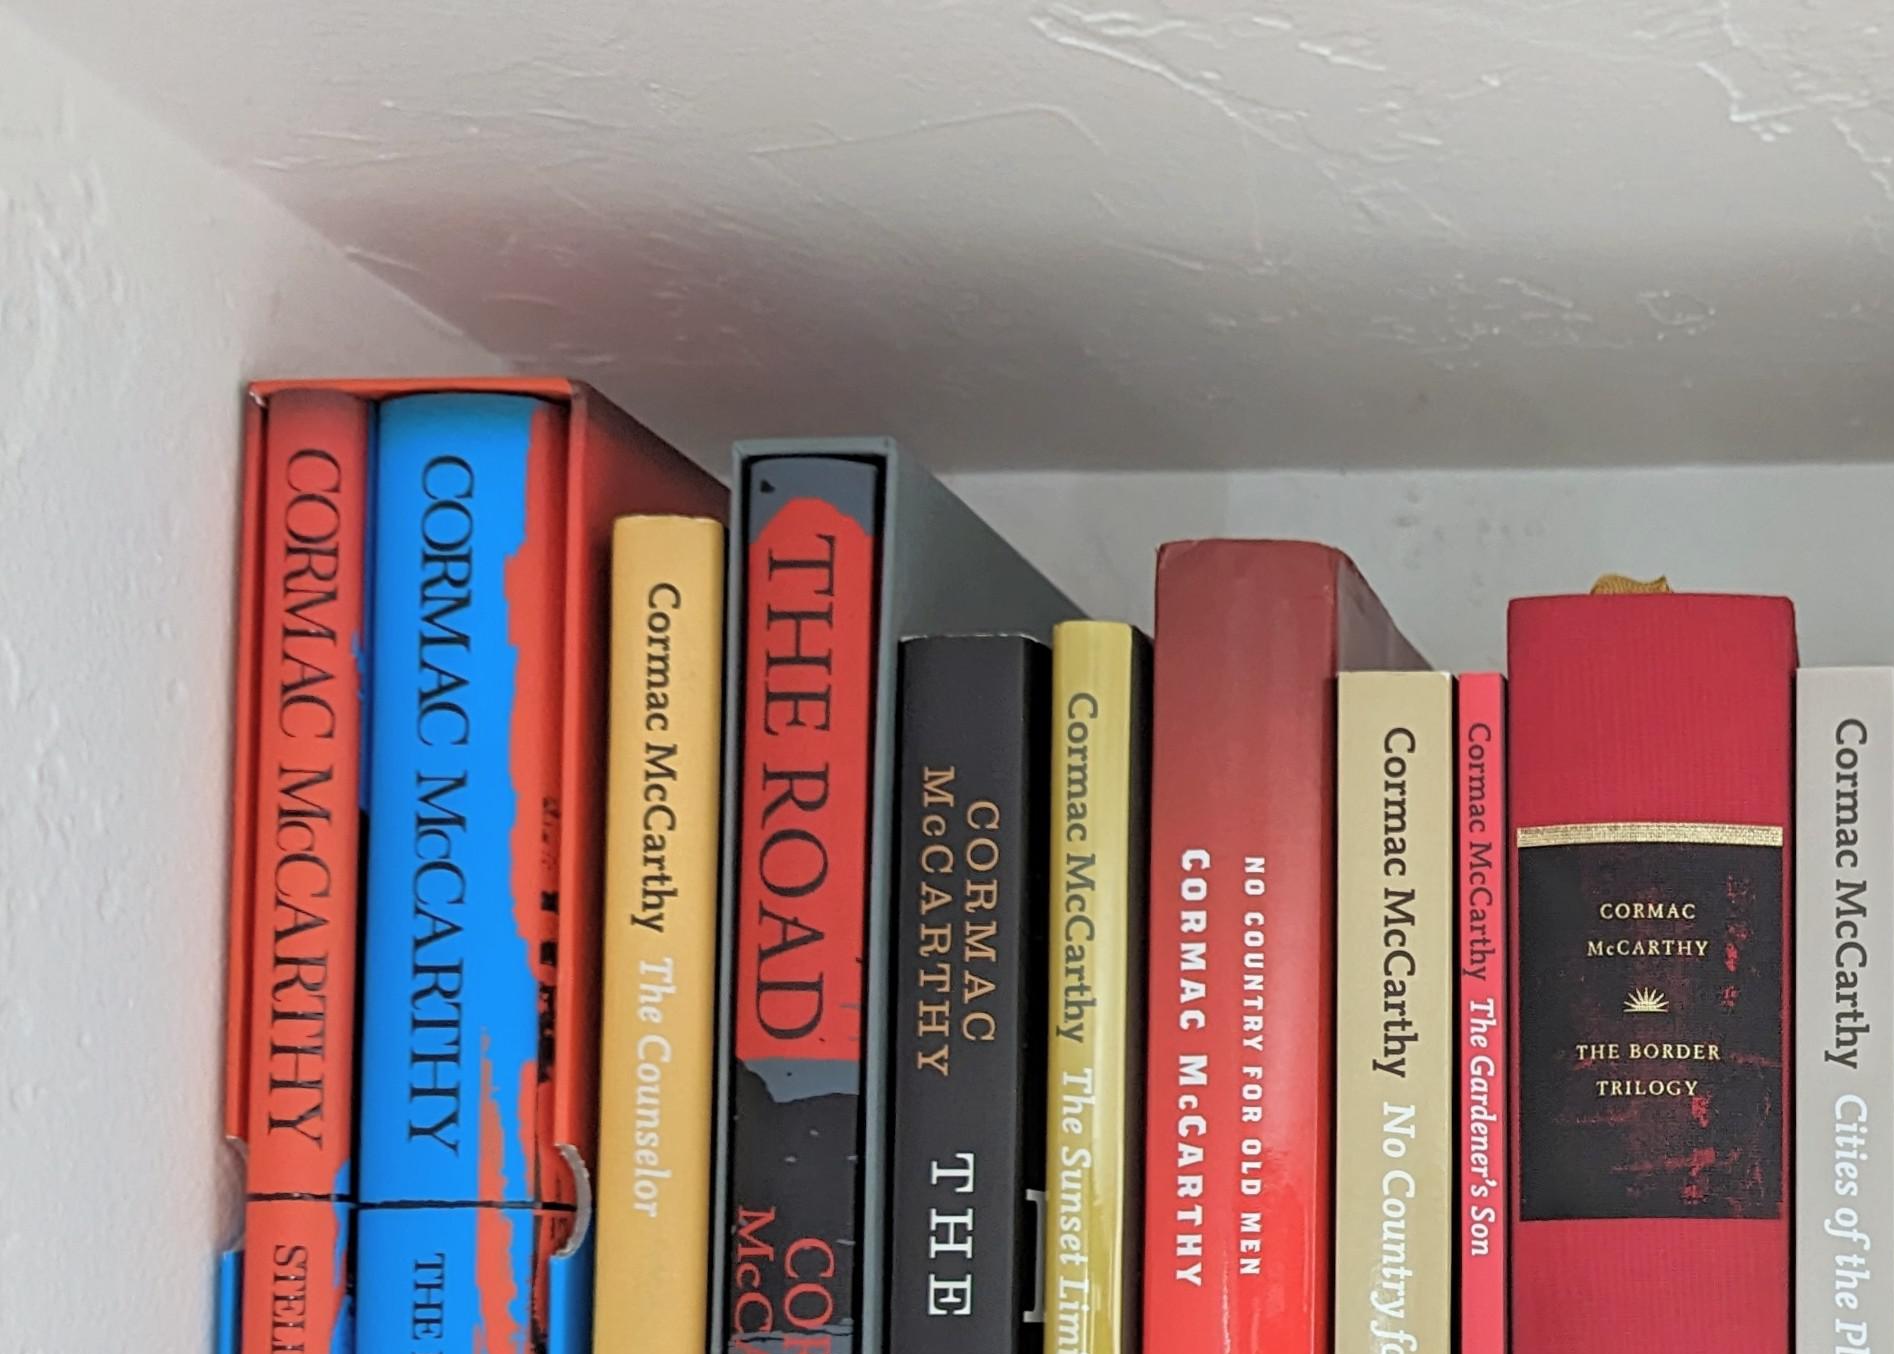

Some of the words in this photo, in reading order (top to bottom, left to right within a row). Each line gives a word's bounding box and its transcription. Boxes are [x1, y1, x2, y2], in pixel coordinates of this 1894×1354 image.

[278, 448, 342, 739] CORMAC
[419, 454, 474, 746] CORMAC
[644, 583, 682, 732] Cormac
[764, 533, 836, 734] THE
[631, 744, 679, 934] McCarthy
[1065, 693, 1099, 841] Cormac
[1382, 727, 1416, 876] Cormac
[1467, 723, 1491, 832] Cormac
[1834, 719, 1867, 867] Cormac
[752, 761, 832, 1041] ROAD
[916, 766, 955, 1076] McCARTHY
[962, 800, 1000, 1042] CORMAC
[1178, 849, 1211, 1030] CORMAC
[1243, 857, 1265, 896] NO
[1462, 842, 1497, 980] McCarthy
[1588, 940, 1709, 957] McCARTHY
[1600, 903, 1696, 920] CORMAC
[267, 764, 334, 1149] McCARTHY
[408, 771, 467, 1157] McCARTHY
[638, 955, 676, 1023] The
[1056, 854, 1098, 1044] McCarthy
[1242, 911, 1265, 1052] COUNTRY
[1372, 889, 1419, 1078] McCarthy
[1824, 879, 1870, 1069] McCarthy
[1241, 1067, 1264, 1124] FOR
[1469, 999, 1495, 1048] The
[1576, 1045, 1620, 1060] THE
[1629, 1044, 1721, 1060] BORDER
[1596, 1080, 1700, 1097] TRILOGY
[635, 1034, 672, 1216] Counselor
[1061, 1068, 1095, 1135] The
[1177, 1055, 1208, 1286] McCARTHY
[1241, 1138, 1263, 1196] OLD
[1381, 1101, 1416, 1159] No
[1832, 1094, 1869, 1197] Cities
[928, 1152, 975, 1316] THE
[1056, 1145, 1092, 1265] Sunset
[1239, 1212, 1262, 1275] MEN
[1370, 1170, 1417, 1319] Country
[1470, 1206, 1489, 1257] Son
[1824, 1208, 1870, 1250] of
[411, 1253, 445, 1340] THE
[1834, 1254, 1871, 1307] the
